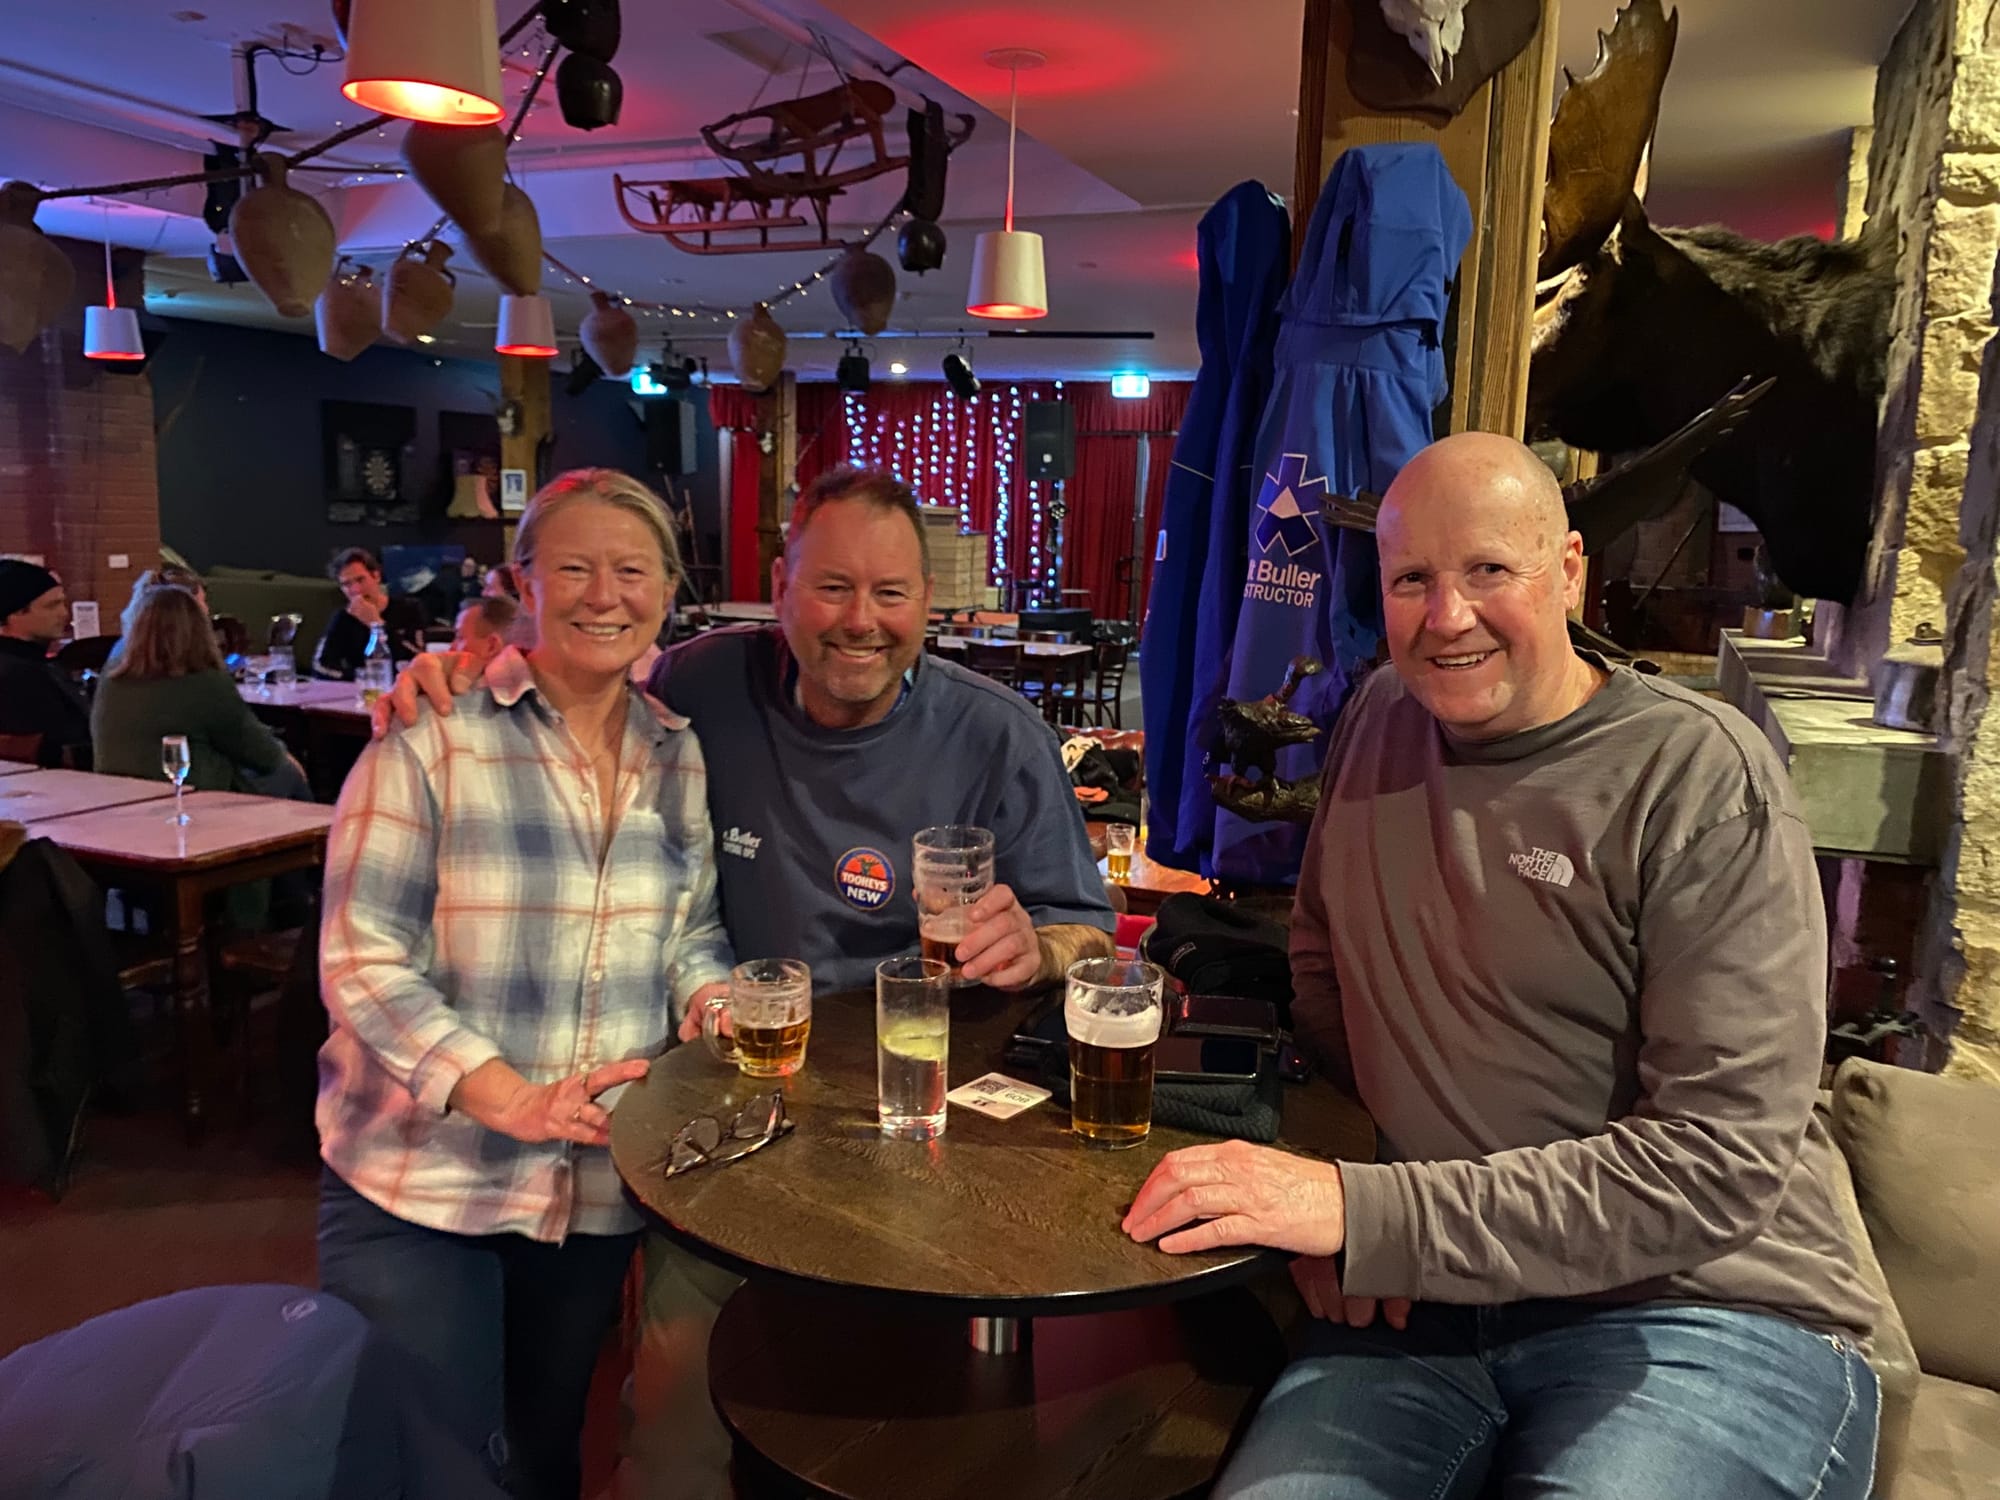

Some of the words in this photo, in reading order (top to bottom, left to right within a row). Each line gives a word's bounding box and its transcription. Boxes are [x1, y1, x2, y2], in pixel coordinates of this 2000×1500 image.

[1257, 559, 1322, 590] Buller
[1508, 853, 1554, 870] NORTH
[1532, 847, 1557, 861] THE
[1517, 865, 1548, 881] FACE
[847, 886, 882, 904] NEW
